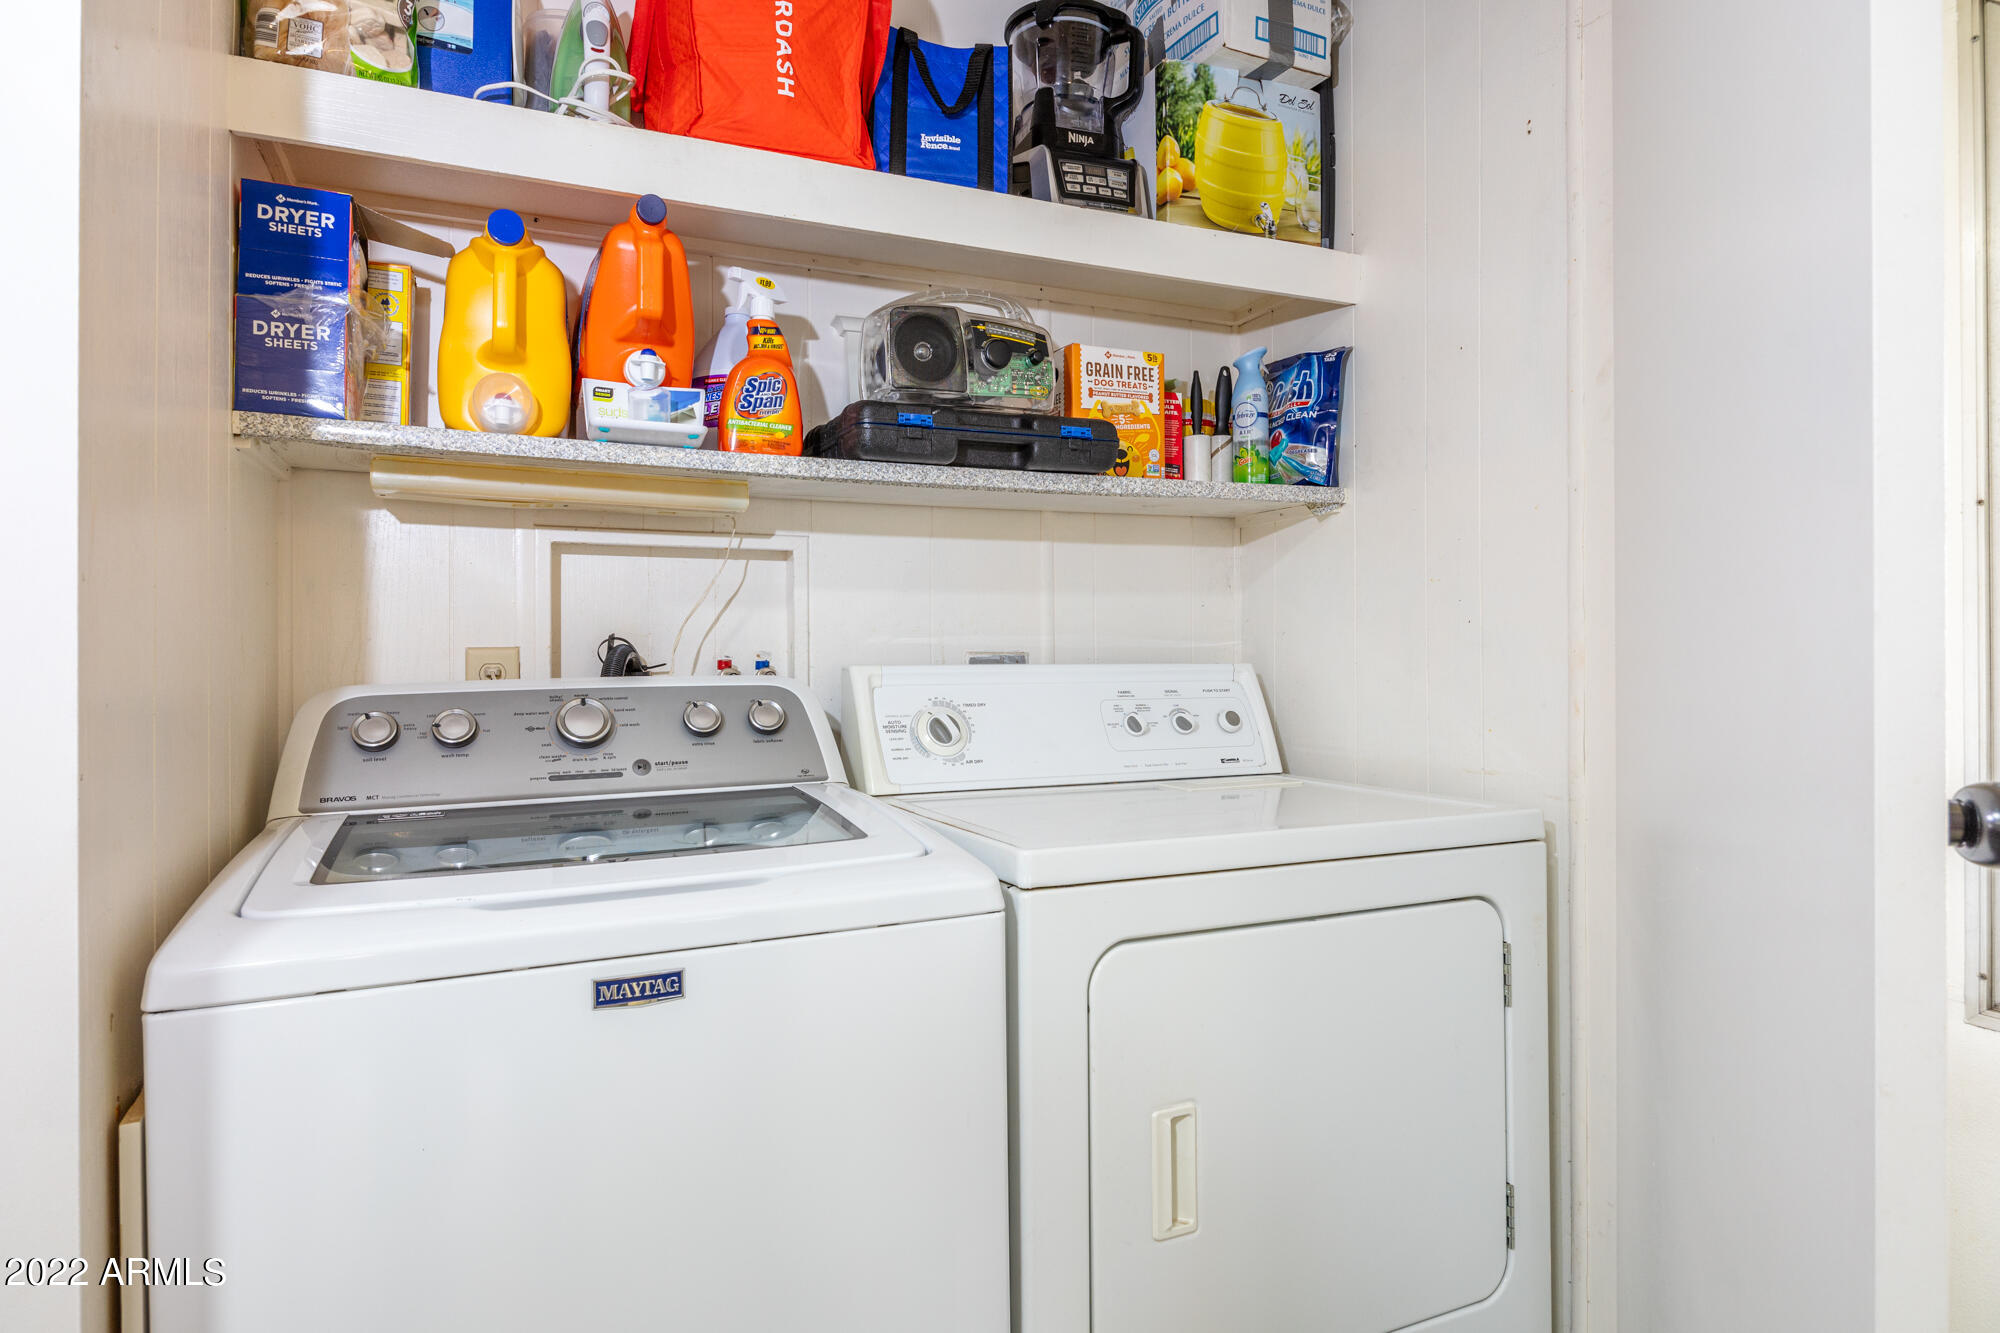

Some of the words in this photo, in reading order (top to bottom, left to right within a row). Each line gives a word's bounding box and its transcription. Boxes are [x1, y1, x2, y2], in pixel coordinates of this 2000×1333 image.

[774, 1, 795, 98] RDASH
[921, 133, 961, 144] Invisible
[257, 203, 336, 230] DRYER
[268, 221, 323, 238] SHEETS
[244, 272, 271, 280] REDUCES
[271, 275, 300, 283] WRINKLES
[264, 280, 290, 288] SOFTENS
[252, 319, 331, 341] DRYER
[264, 337, 319, 351] SHEETS
[1147, 353, 1153, 362] 5
[1086, 361, 1123, 379] GRAIN
[1127, 365, 1155, 383] FREE
[744, 376, 782, 396] Spic
[1093, 379, 1114, 387] DOG
[1116, 380, 1148, 390] TREATS
[738, 392, 784, 414] Span
[1118, 414, 1126, 424] 5
[1285, 411, 1317, 422] CLEAN
[728, 419, 769, 428] ANTIBACTERIAL
[769, 423, 793, 431] CLEANER
[319, 795, 357, 803] BRAVOS
[597, 976, 680, 1002] MAYTAG
